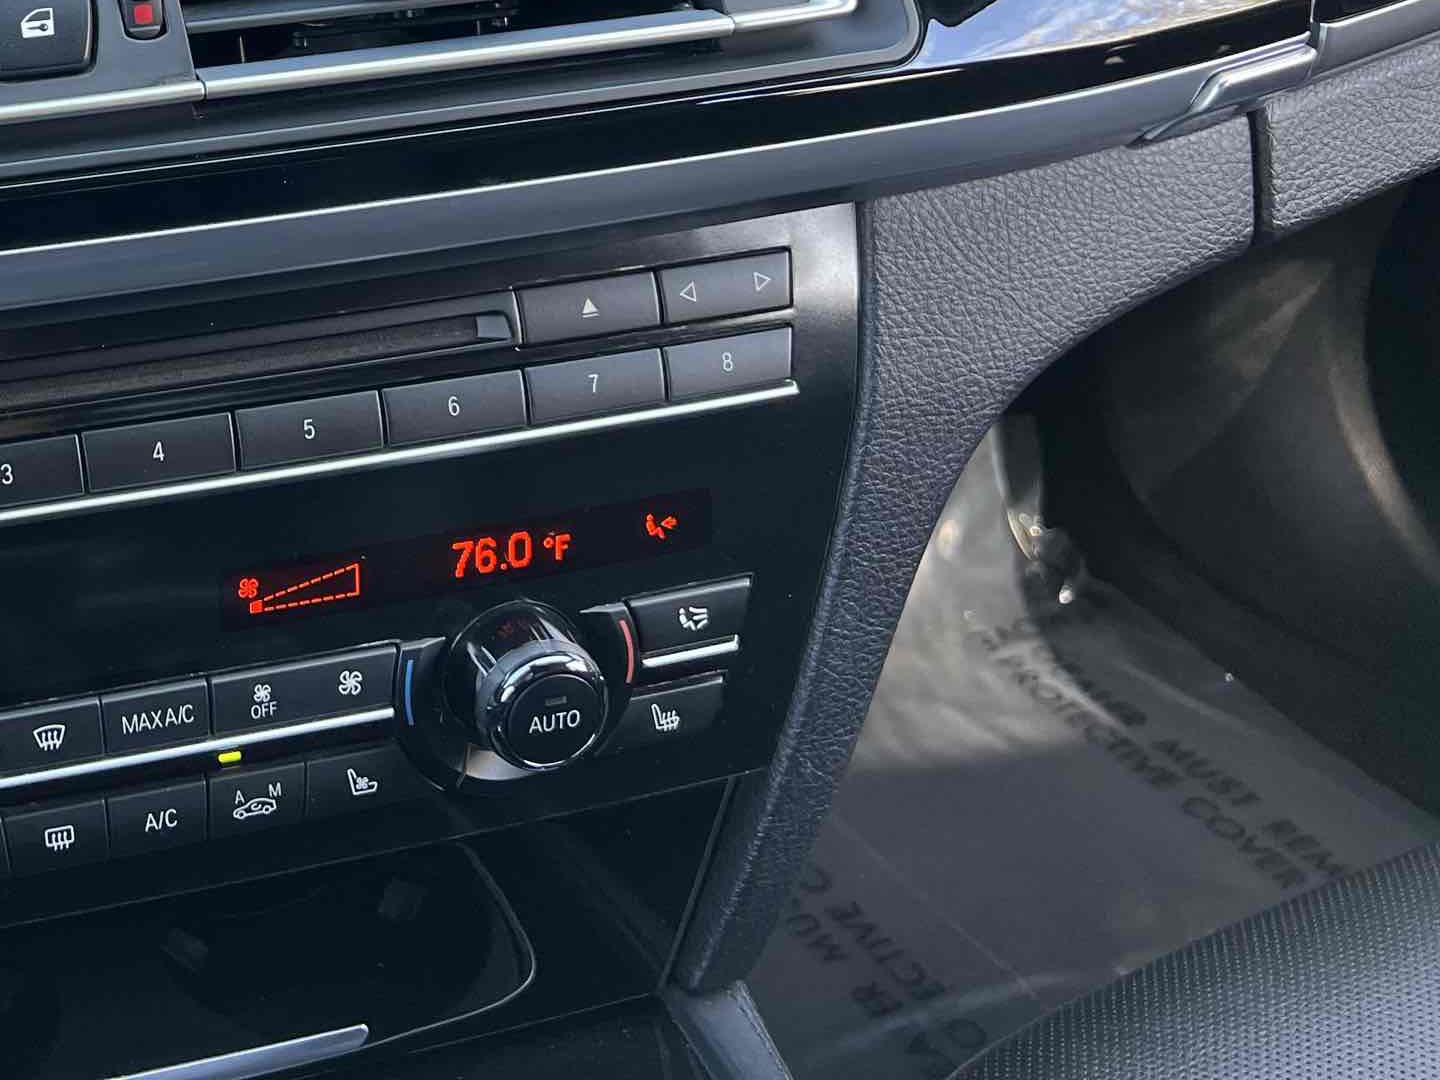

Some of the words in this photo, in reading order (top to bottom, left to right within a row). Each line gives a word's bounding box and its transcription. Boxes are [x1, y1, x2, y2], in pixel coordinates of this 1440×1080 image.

[721, 352, 735, 372] 8
[587, 374, 600, 393] 7
[447, 396, 461, 417] 6
[302, 418, 316, 441] 5
[151, 440, 165, 463] 4
[0, 463, 15, 486] 3
[451, 531, 533, 579] 76.0
[121, 713, 164, 736] MAX
[164, 704, 195, 727] A/C
[250, 701, 279, 721] OFF
[528, 708, 581, 735] AUTO
[233, 789, 245, 805] A
[267, 782, 283, 799] M
[143, 807, 179, 833] A/C
